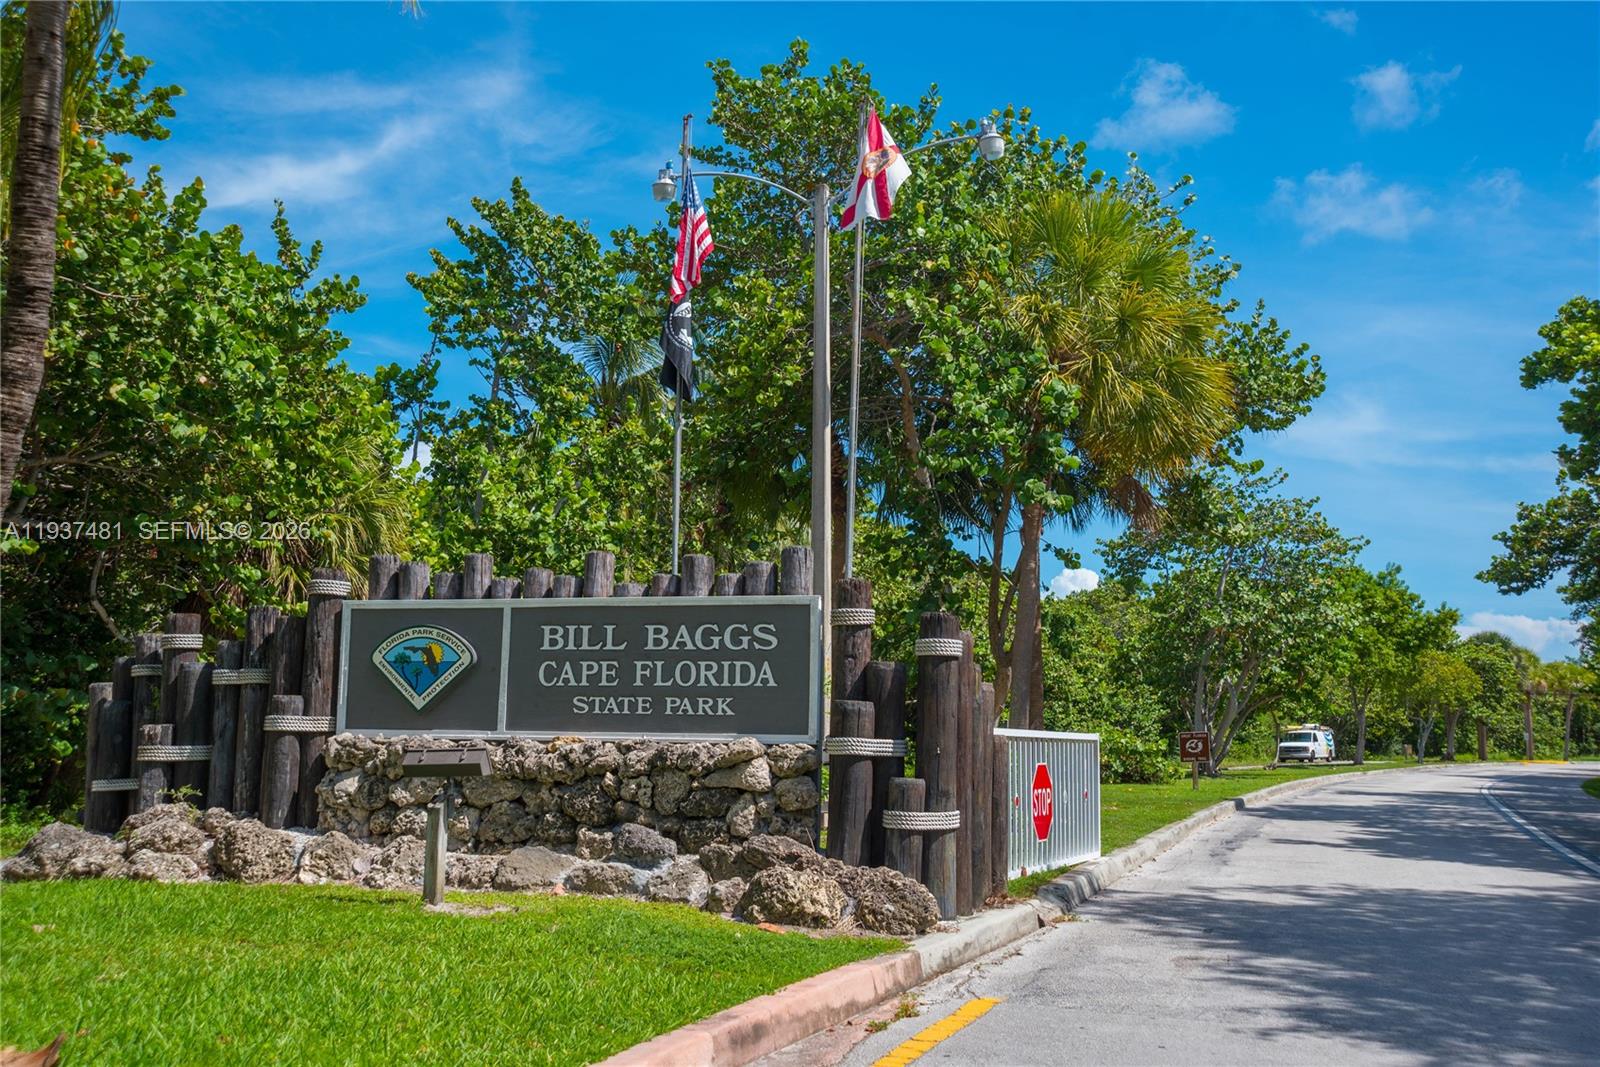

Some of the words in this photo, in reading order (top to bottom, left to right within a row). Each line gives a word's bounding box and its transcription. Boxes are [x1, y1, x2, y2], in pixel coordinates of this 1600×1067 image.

[378, 632, 410, 655] FLORIDA
[436, 631, 467, 656] SERVICE
[540, 624, 628, 650] BILL
[644, 624, 778, 650] BAGGS
[378, 660, 416, 701] ENVIRONMENTAL
[422, 661, 464, 702] PROTECTION
[538, 661, 620, 687] CAPE
[633, 661, 778, 687] FLORIDA
[572, 696, 654, 714] STATE
[664, 697, 735, 716] PARK
[1033, 788, 1052, 817] STOP
